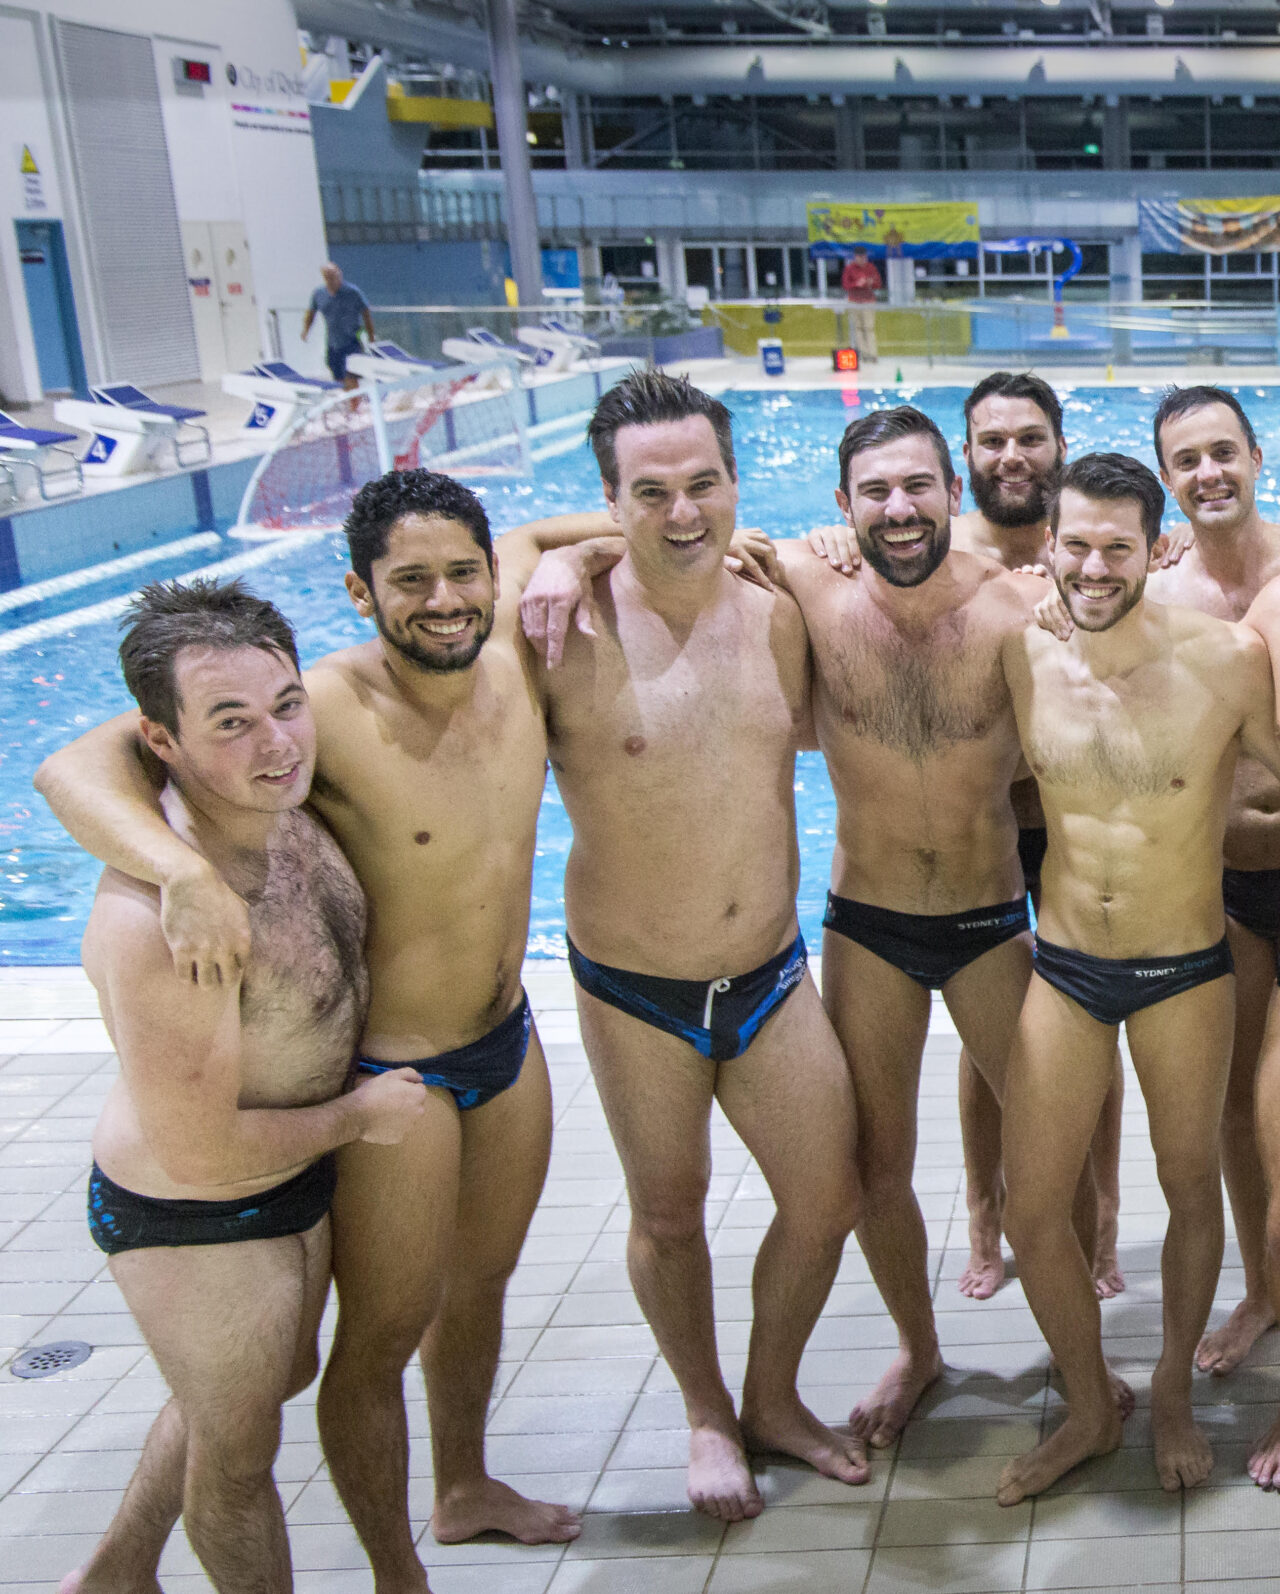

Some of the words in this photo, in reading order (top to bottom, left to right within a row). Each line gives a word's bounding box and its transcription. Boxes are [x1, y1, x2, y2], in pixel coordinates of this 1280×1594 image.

[91, 438, 107, 460] 4
[957, 917, 1001, 930] SYDNEY
[1135, 967, 1177, 978] SYDNEY
